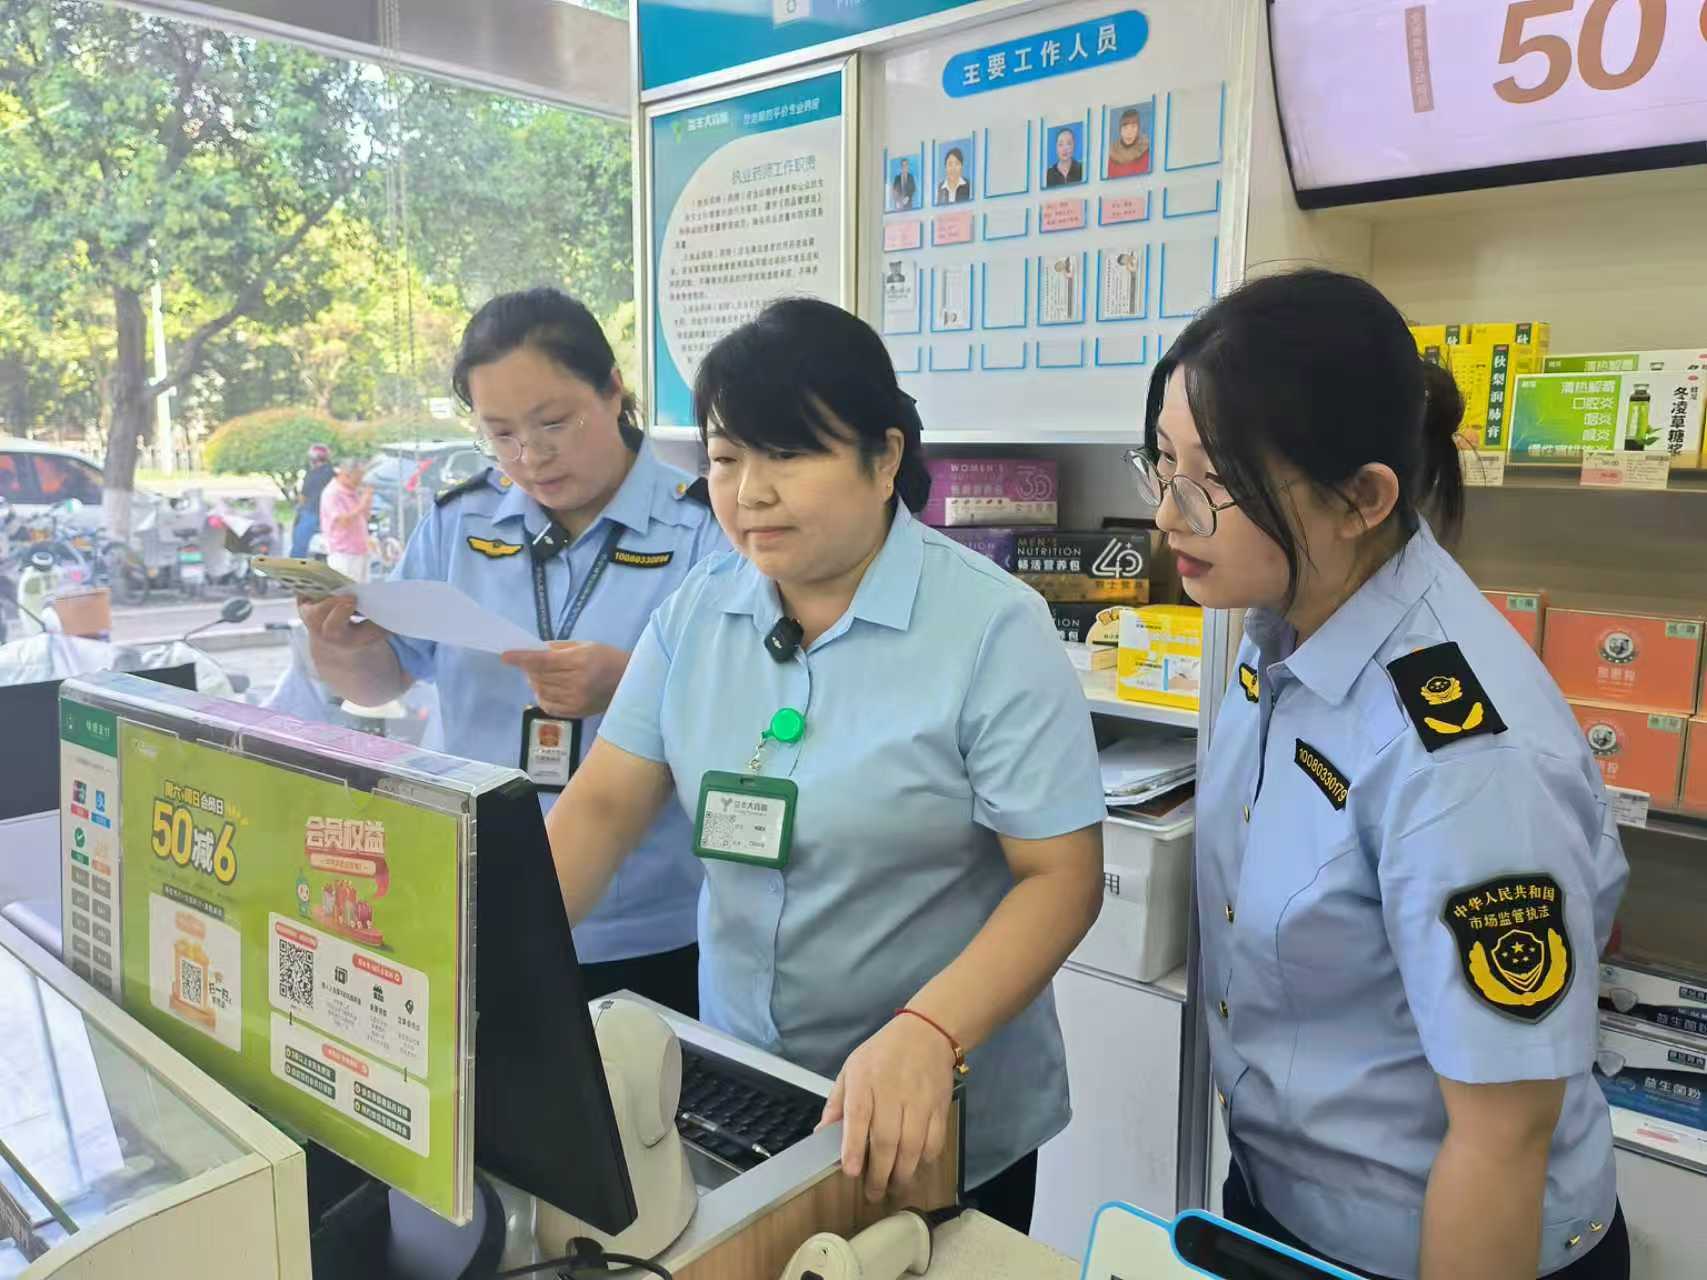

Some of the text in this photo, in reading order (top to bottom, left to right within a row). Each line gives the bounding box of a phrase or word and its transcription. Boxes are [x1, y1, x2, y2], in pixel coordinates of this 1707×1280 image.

[1493, 0, 1667, 103] 50
[1017, 547, 1081, 557] NUTRITION
[1453, 884, 1555, 918] 中华人民共和国
[1469, 905, 1551, 929] 市场监管执法
